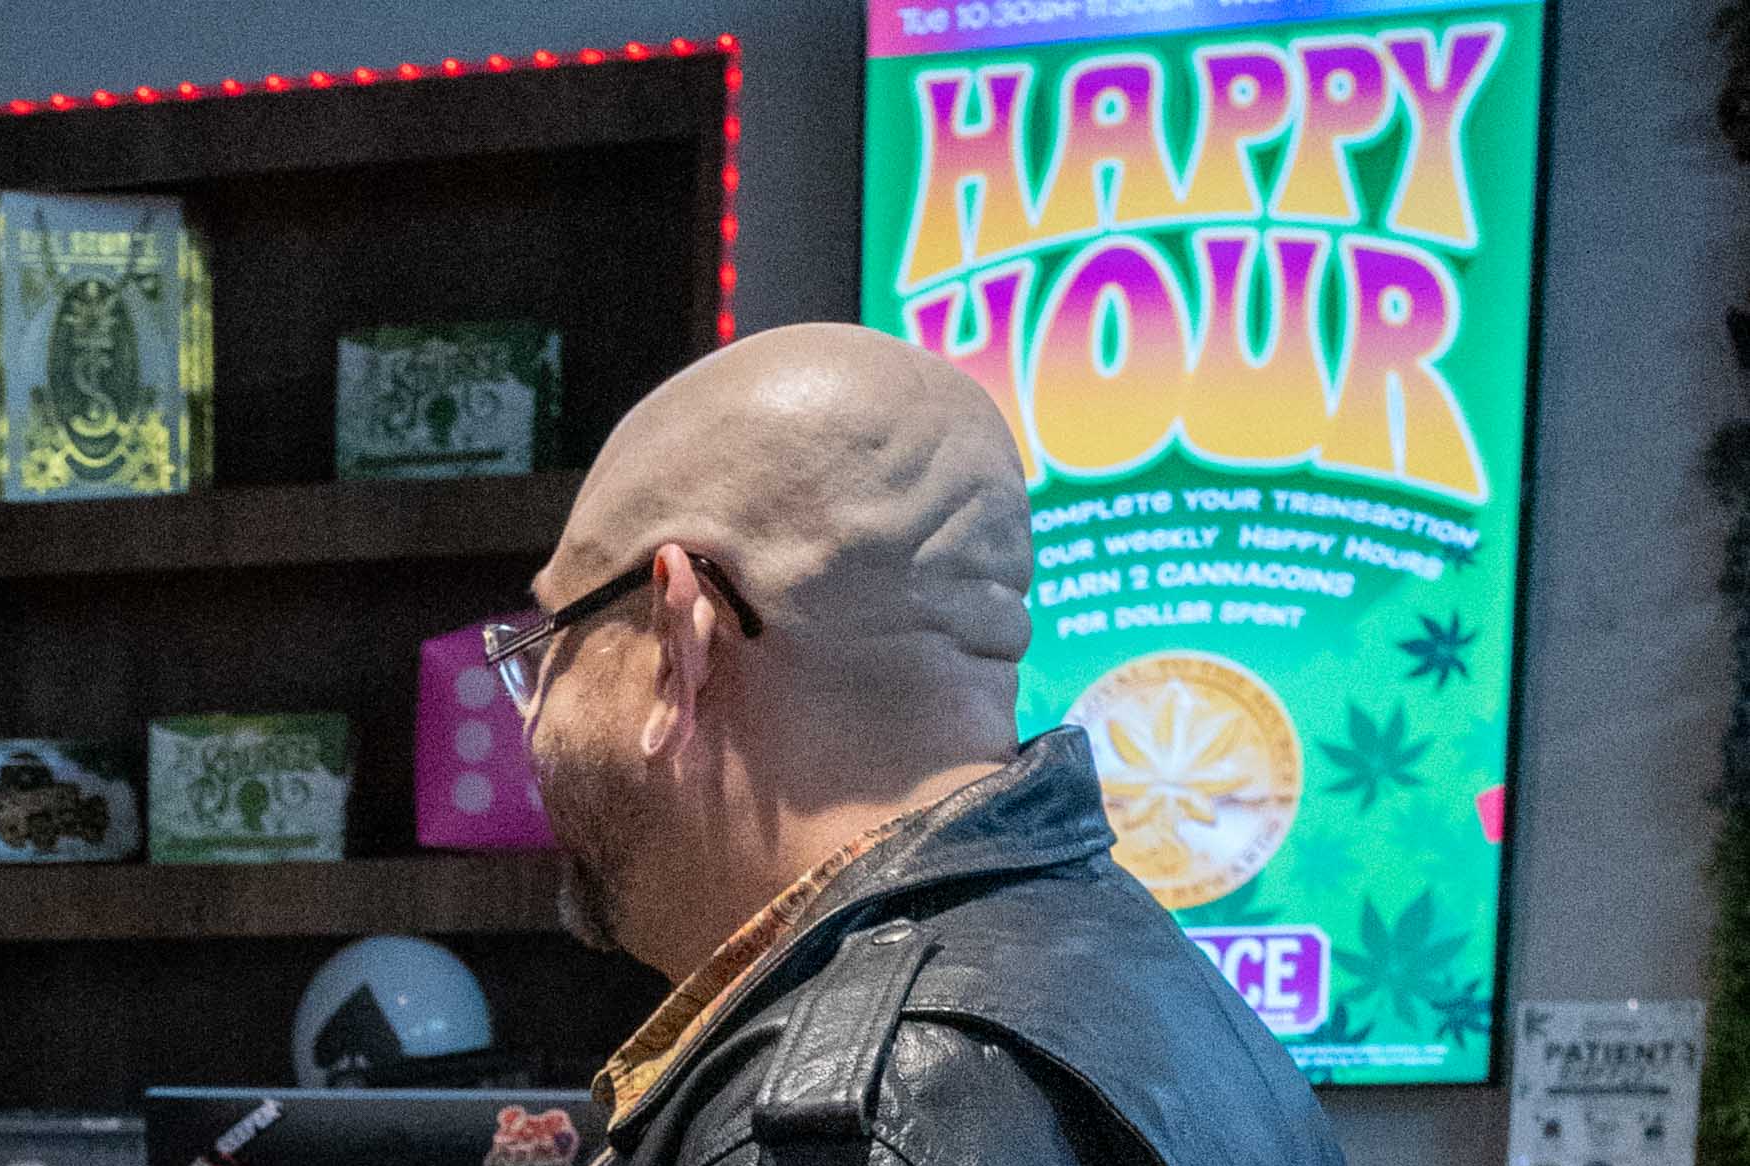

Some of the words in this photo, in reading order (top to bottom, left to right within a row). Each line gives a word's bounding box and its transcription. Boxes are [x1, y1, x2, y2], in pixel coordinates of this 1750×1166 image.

[896, 22, 1505, 296] HAPPY
[903, 226, 1490, 505] HOUR
[1029, 489, 1174, 533] OMPLETE
[1182, 487, 1261, 512] YOUR
[1103, 526, 1220, 556] WEEKLY
[1036, 567, 1121, 607] EARN
[1128, 563, 1150, 591] 2
[1155, 561, 1356, 598] CANNACOINS
